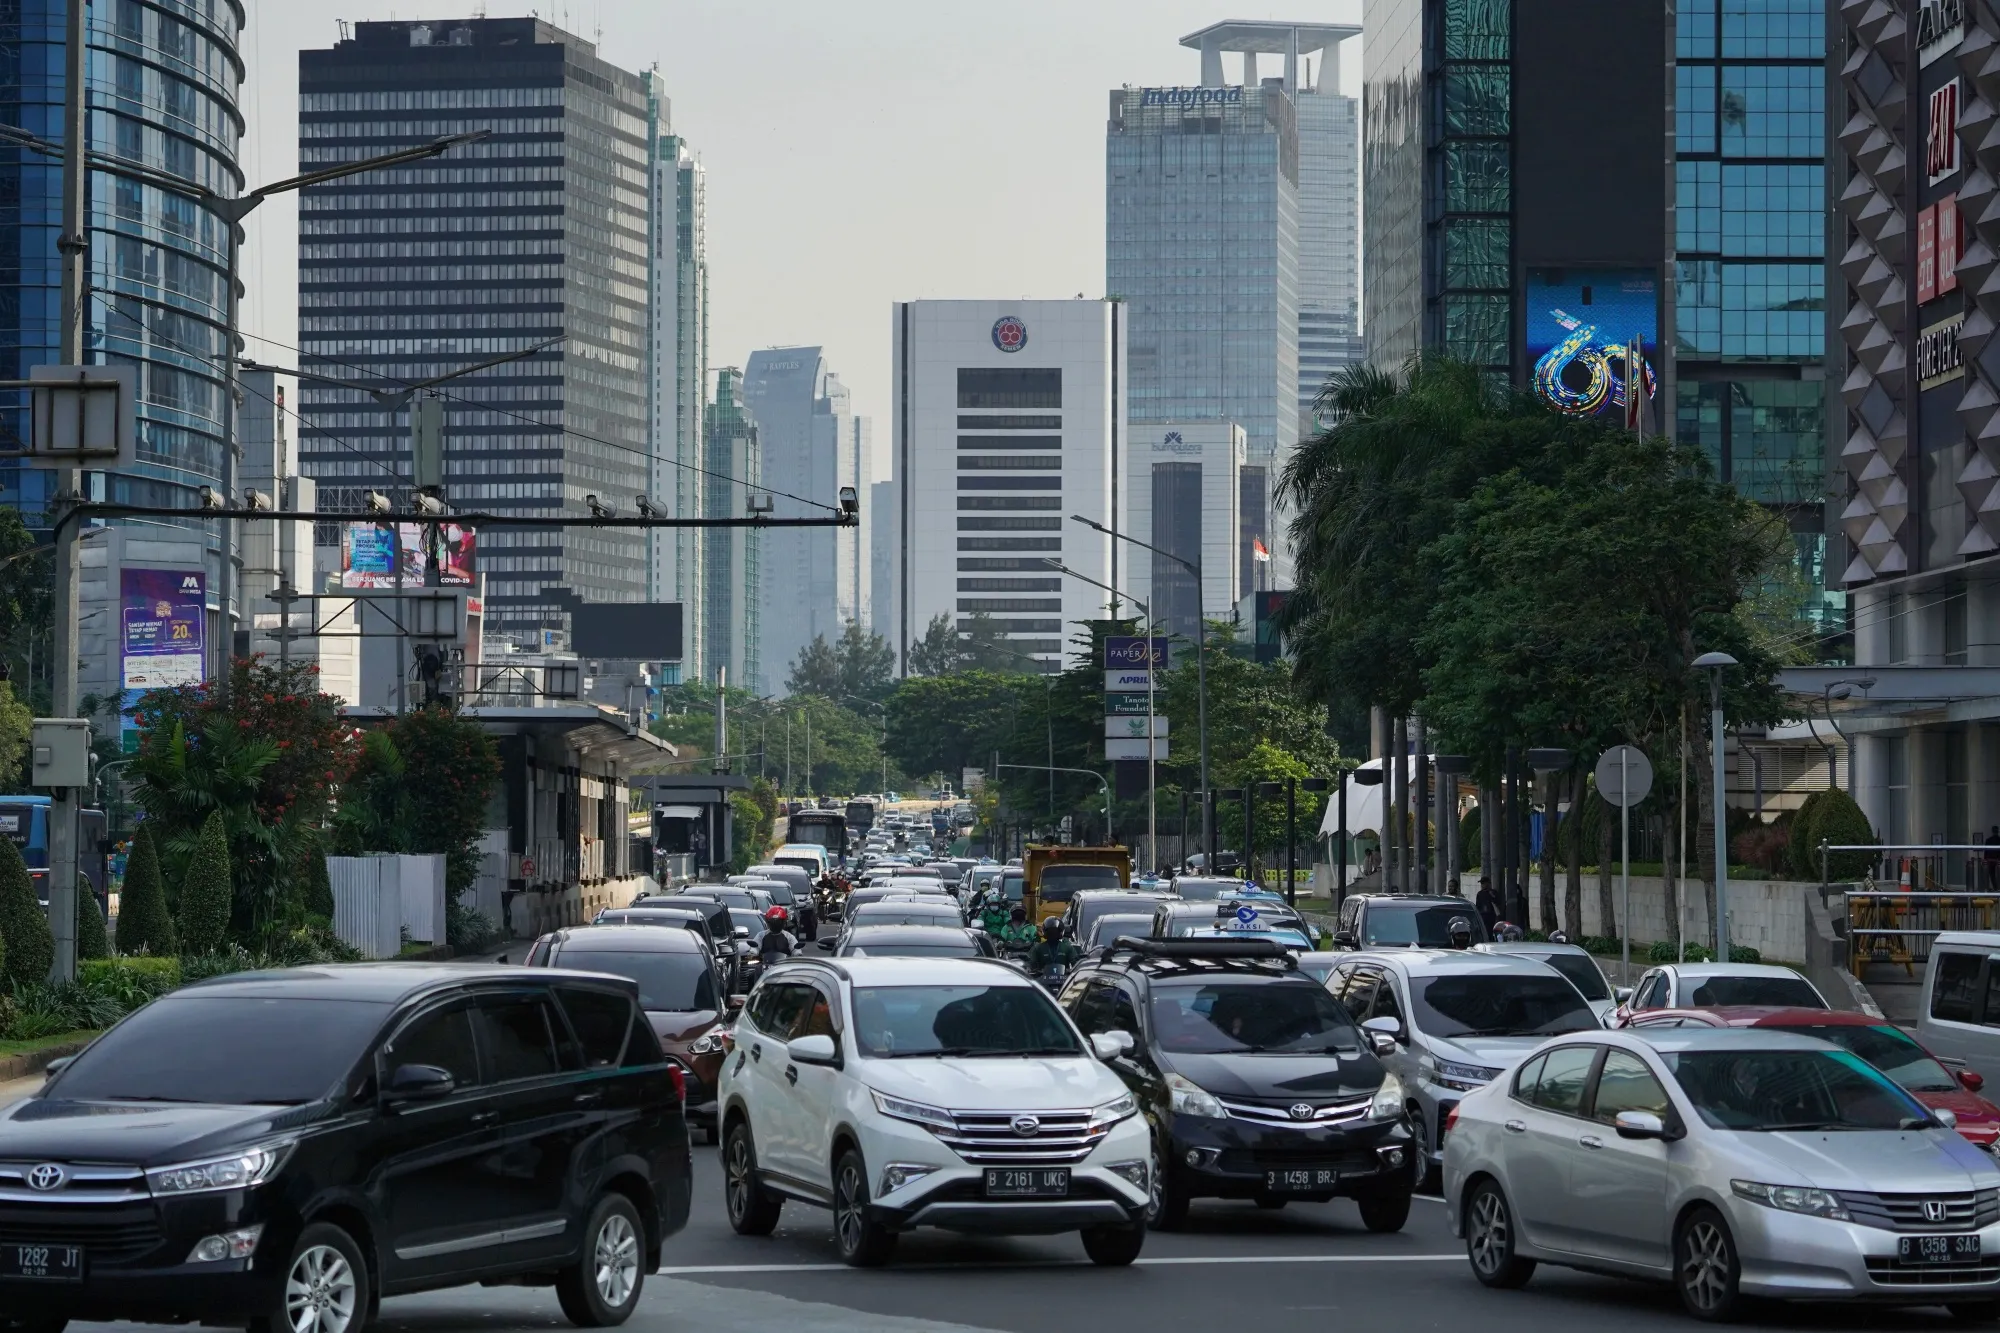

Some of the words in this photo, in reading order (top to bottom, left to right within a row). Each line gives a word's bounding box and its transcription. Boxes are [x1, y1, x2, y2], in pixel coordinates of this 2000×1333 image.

[1140, 85, 1242, 112] Indofood
[1940, 206, 1955, 242] UNI
[1916, 325, 1952, 381] FOREVER
[769, 361, 800, 371] RAFFLES
[1110, 650, 1141, 658] PAPER
[1118, 676, 1148, 684] APRIL
[1114, 704, 1158, 712] Foundatin
[988, 1172, 997, 1187] B
[1005, 1172, 1033, 1187] 2161
[1043, 1172, 1065, 1187] UKC
[1284, 1170, 1309, 1185] 1458
[1317, 1170, 1337, 1184] BRJ
[1901, 1238, 1910, 1255] B
[1919, 1237, 1948, 1255] 1358
[1955, 1236, 1979, 1253] SAC
[18, 1247, 49, 1267] 1282
[62, 1249, 78, 1267] JT
